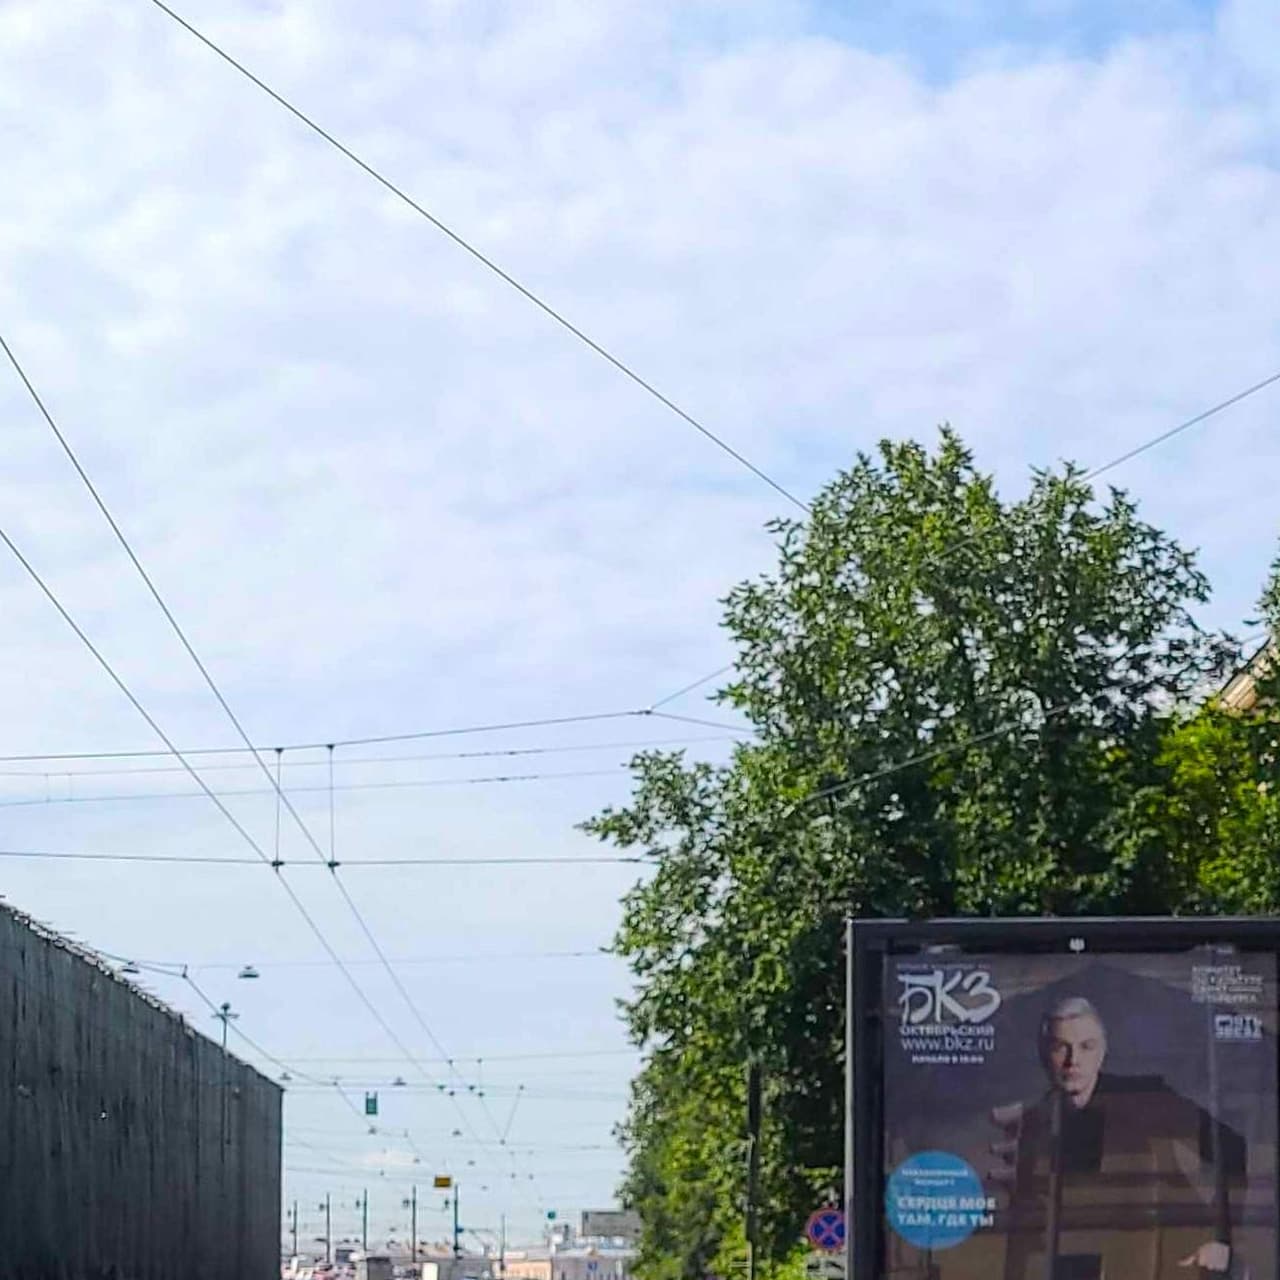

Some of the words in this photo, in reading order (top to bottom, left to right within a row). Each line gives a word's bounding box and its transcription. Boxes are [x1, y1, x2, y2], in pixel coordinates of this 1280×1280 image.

[898, 971, 1001, 1027] БКЗ
[902, 1037, 995, 1051] www.bkz.ru
[897, 1197, 957, 1211] СЕРДЦЕ
[898, 1213, 936, 1226] ТАМ,
[937, 1213, 967, 1227] ГДЕ
[969, 1213, 994, 1227] ТЫ
